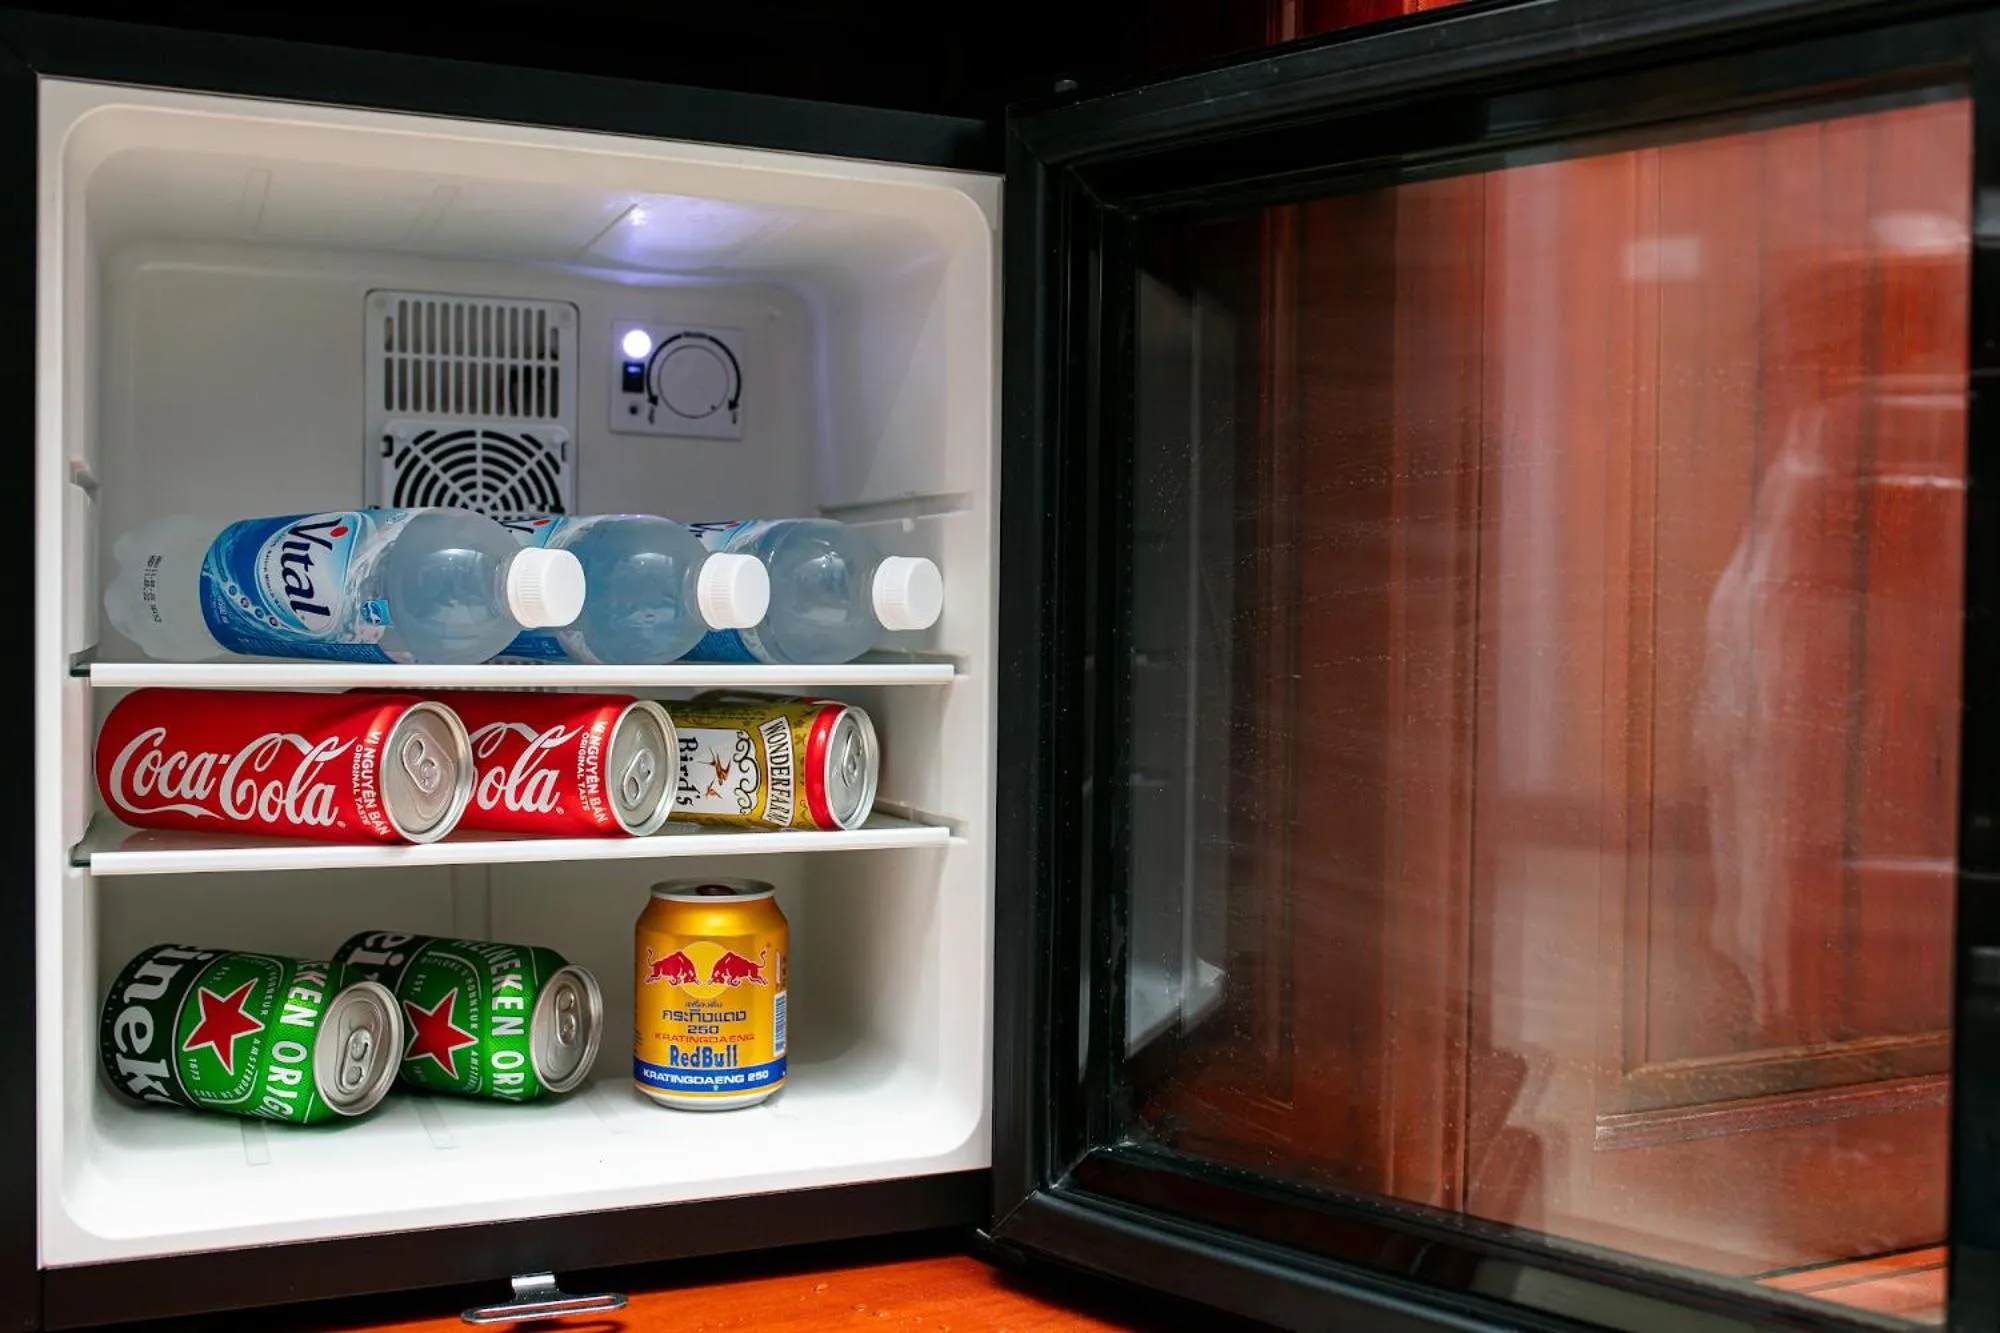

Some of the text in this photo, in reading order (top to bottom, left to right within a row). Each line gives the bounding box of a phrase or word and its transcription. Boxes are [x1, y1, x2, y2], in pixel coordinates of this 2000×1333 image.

[281, 517, 344, 617] Vital
[110, 727, 357, 827] Coca-Cola
[352, 744, 371, 826] ORIGINAL TASTE
[577, 732, 590, 812] ORIGINAL TASTE
[764, 720, 790, 824] WONDERFARM
[654, 1033, 755, 1044] KRATINGDAENG
[687, 1025, 719, 1035] 250
[643, 1068, 769, 1085] KRATINGDAENG 250
